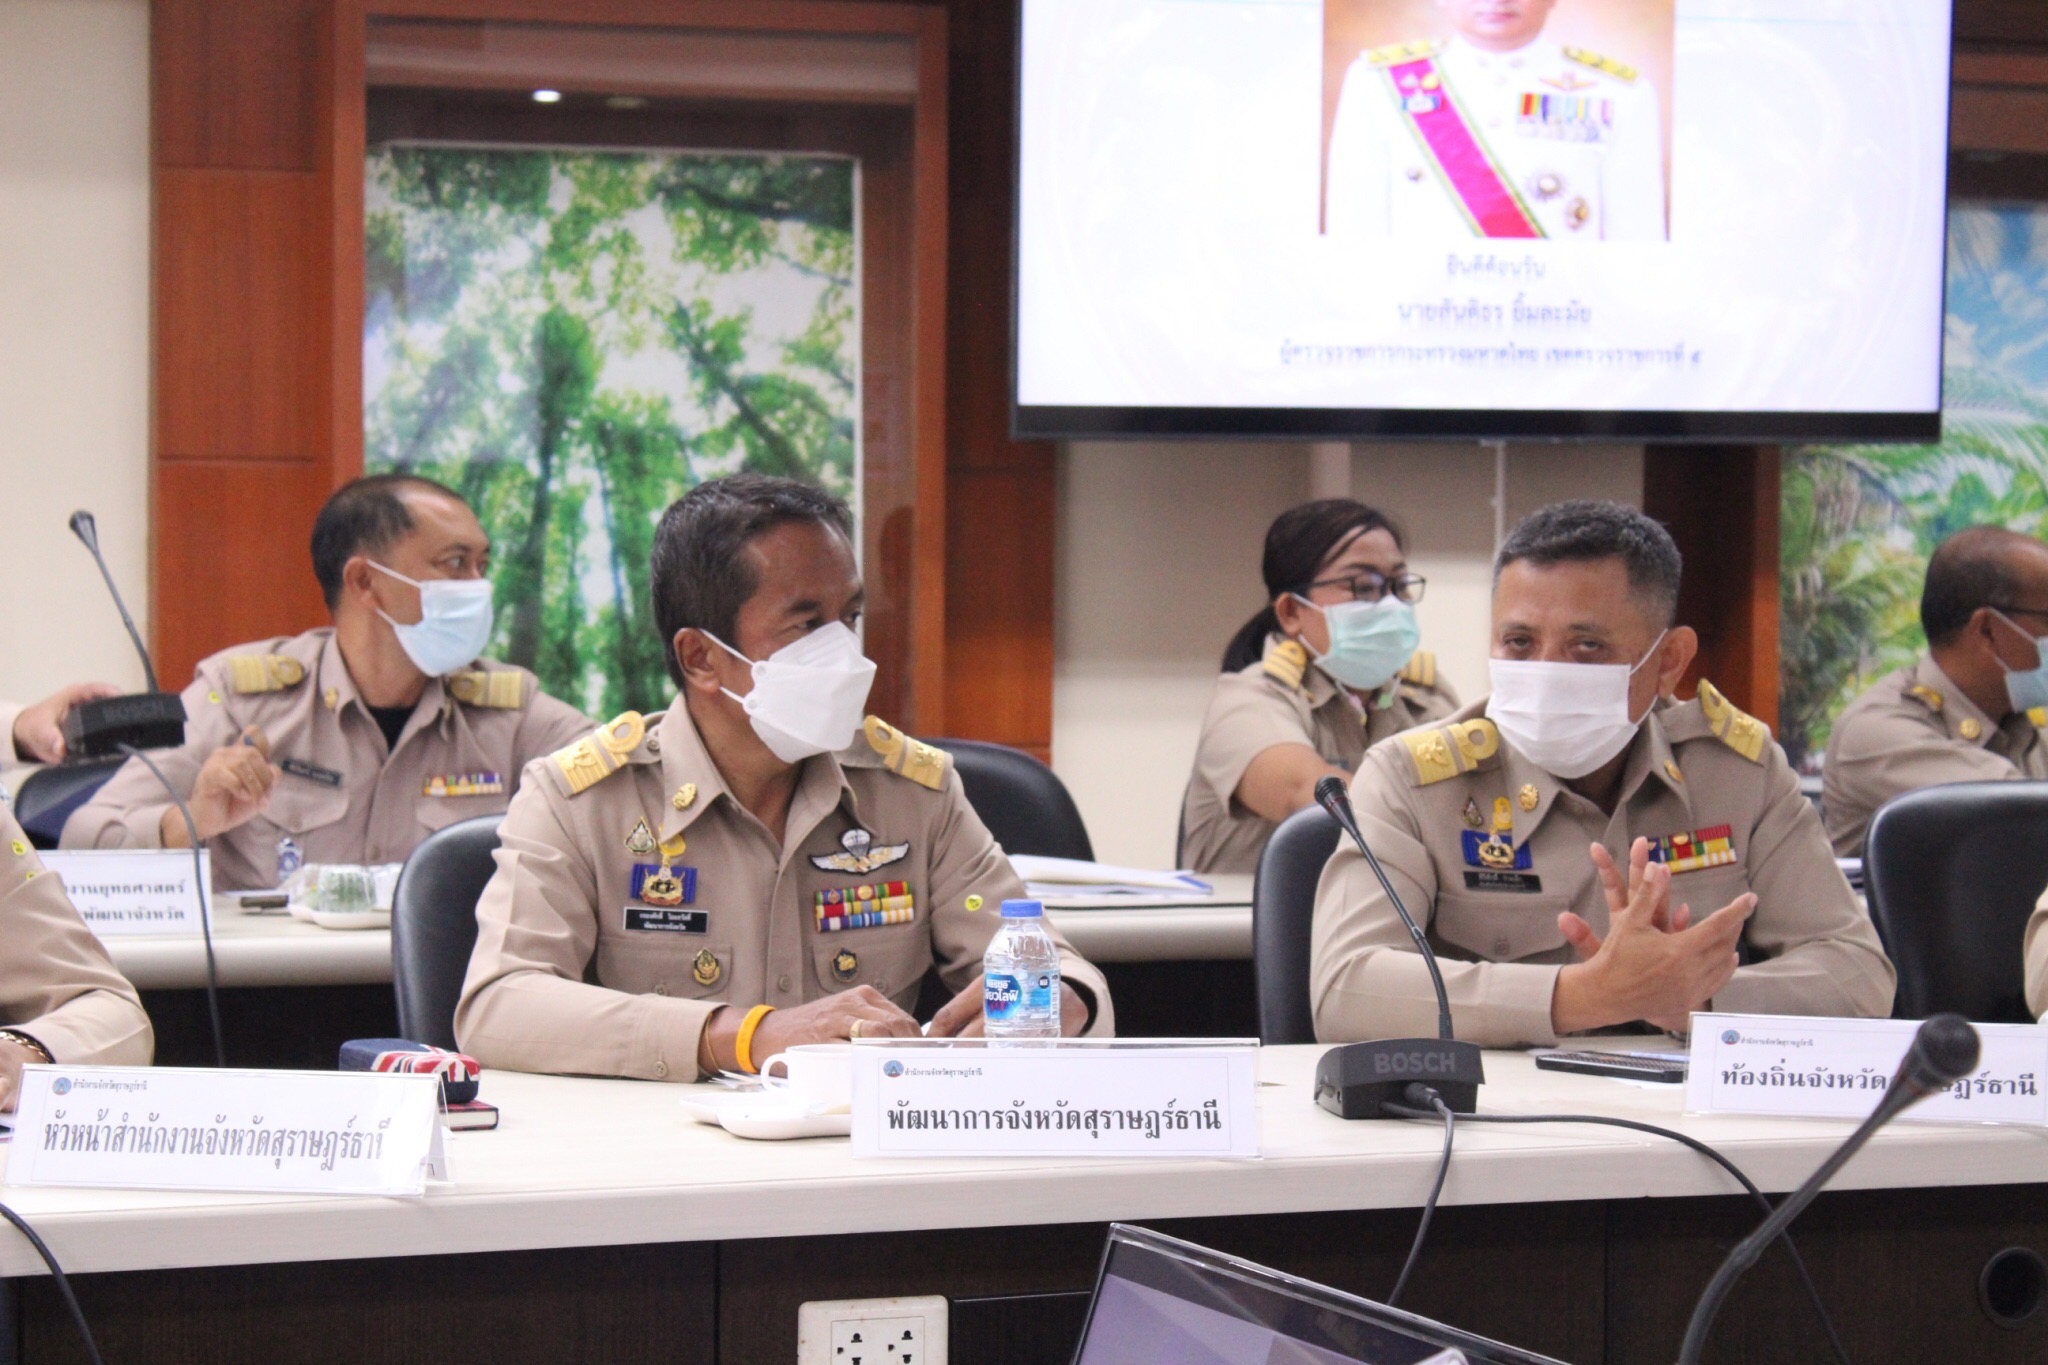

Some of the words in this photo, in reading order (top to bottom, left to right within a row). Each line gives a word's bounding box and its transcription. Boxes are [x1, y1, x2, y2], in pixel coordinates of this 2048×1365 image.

[1374, 1052, 1456, 1074] BOSCH
[887, 1099, 1222, 1138] พัฒนาการจังหวัดสุราษฎร์ธานี
